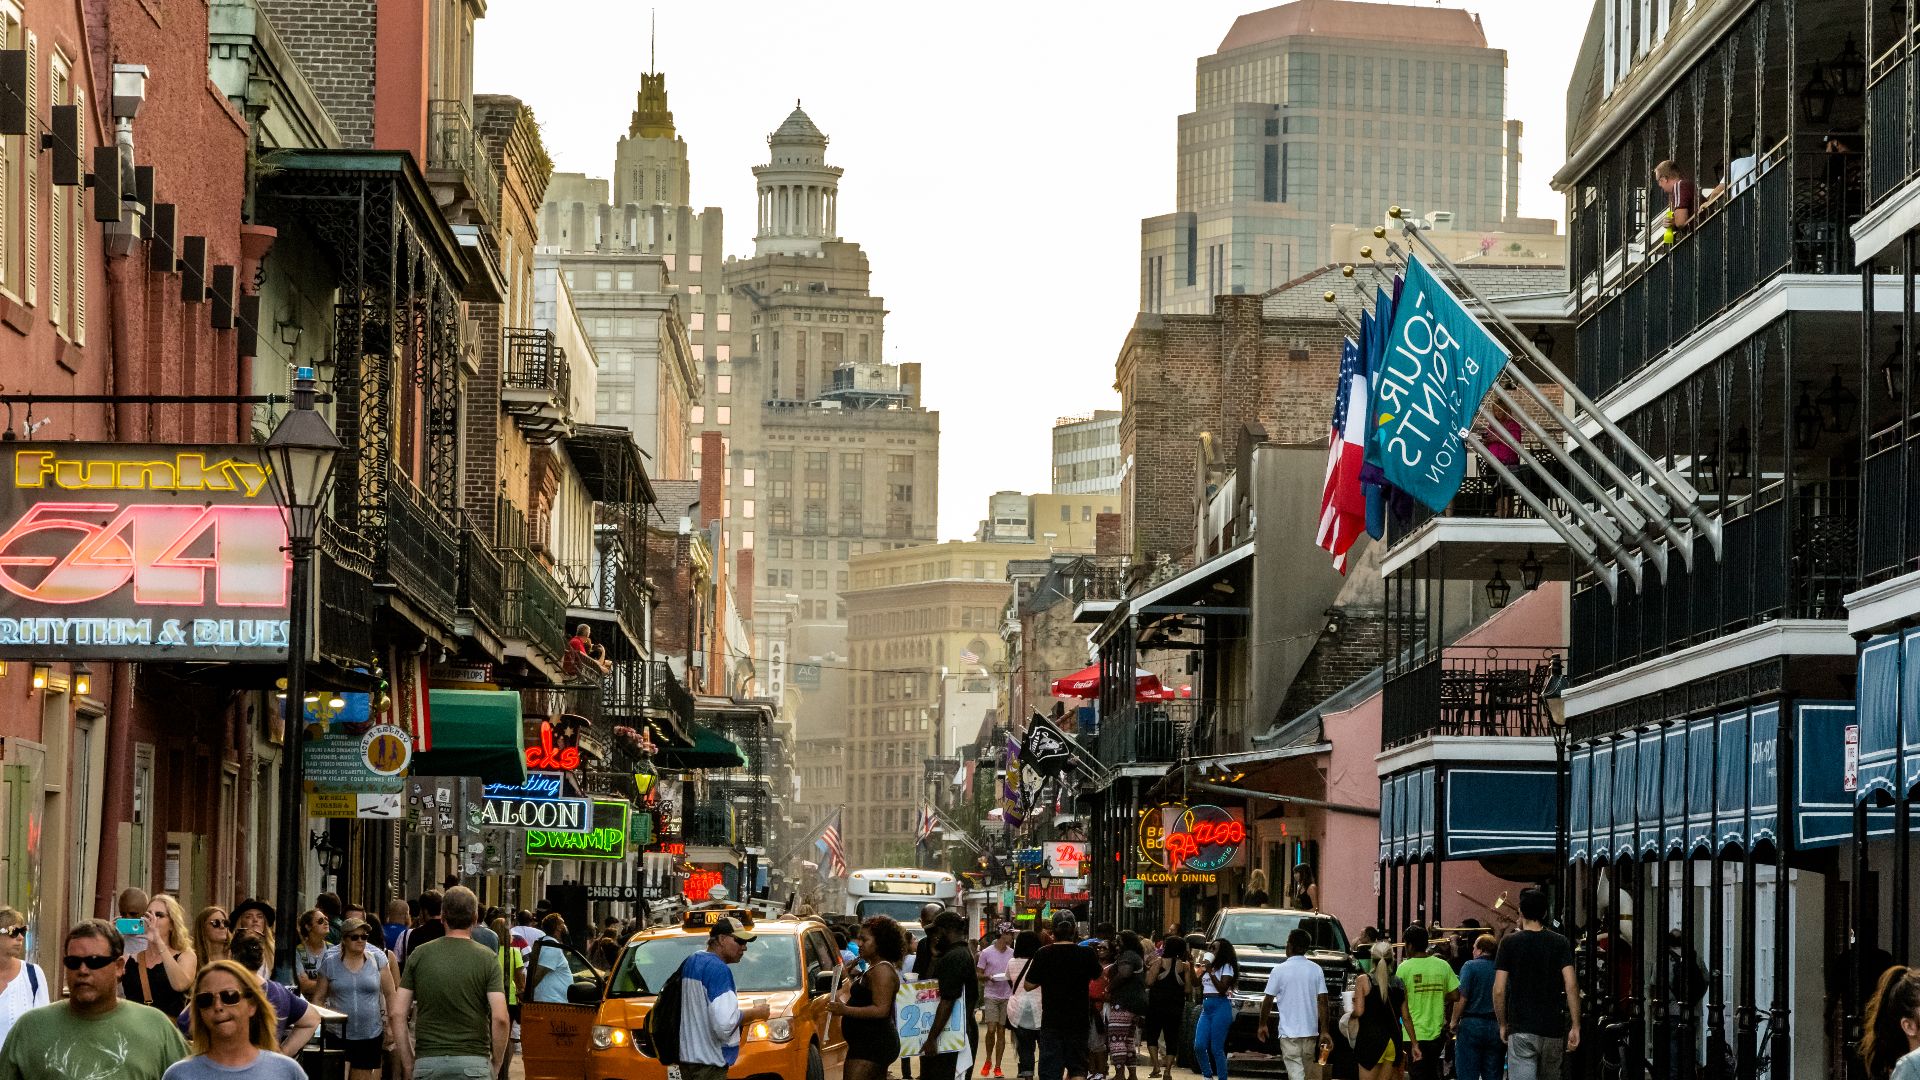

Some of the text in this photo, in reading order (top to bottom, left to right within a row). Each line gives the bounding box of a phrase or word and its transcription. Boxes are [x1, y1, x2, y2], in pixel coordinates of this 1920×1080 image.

[15, 450, 273, 497] Funky
[0, 502, 292, 607] 544
[0, 617, 291, 647] RHYTHM & BLUES
[481, 798, 580, 828] ALOON
[529, 827, 623, 852] SWAMP
[1146, 838, 1164, 849] BO
[1147, 826, 1165, 838] BA
[1165, 820, 1246, 873] RAZZOO
[1136, 873, 1217, 883] BALCONY DINING
[587, 886, 620, 898] CHRIS
[549, 1020, 579, 1033] Yellow
[899, 1004, 921, 1037] 2
